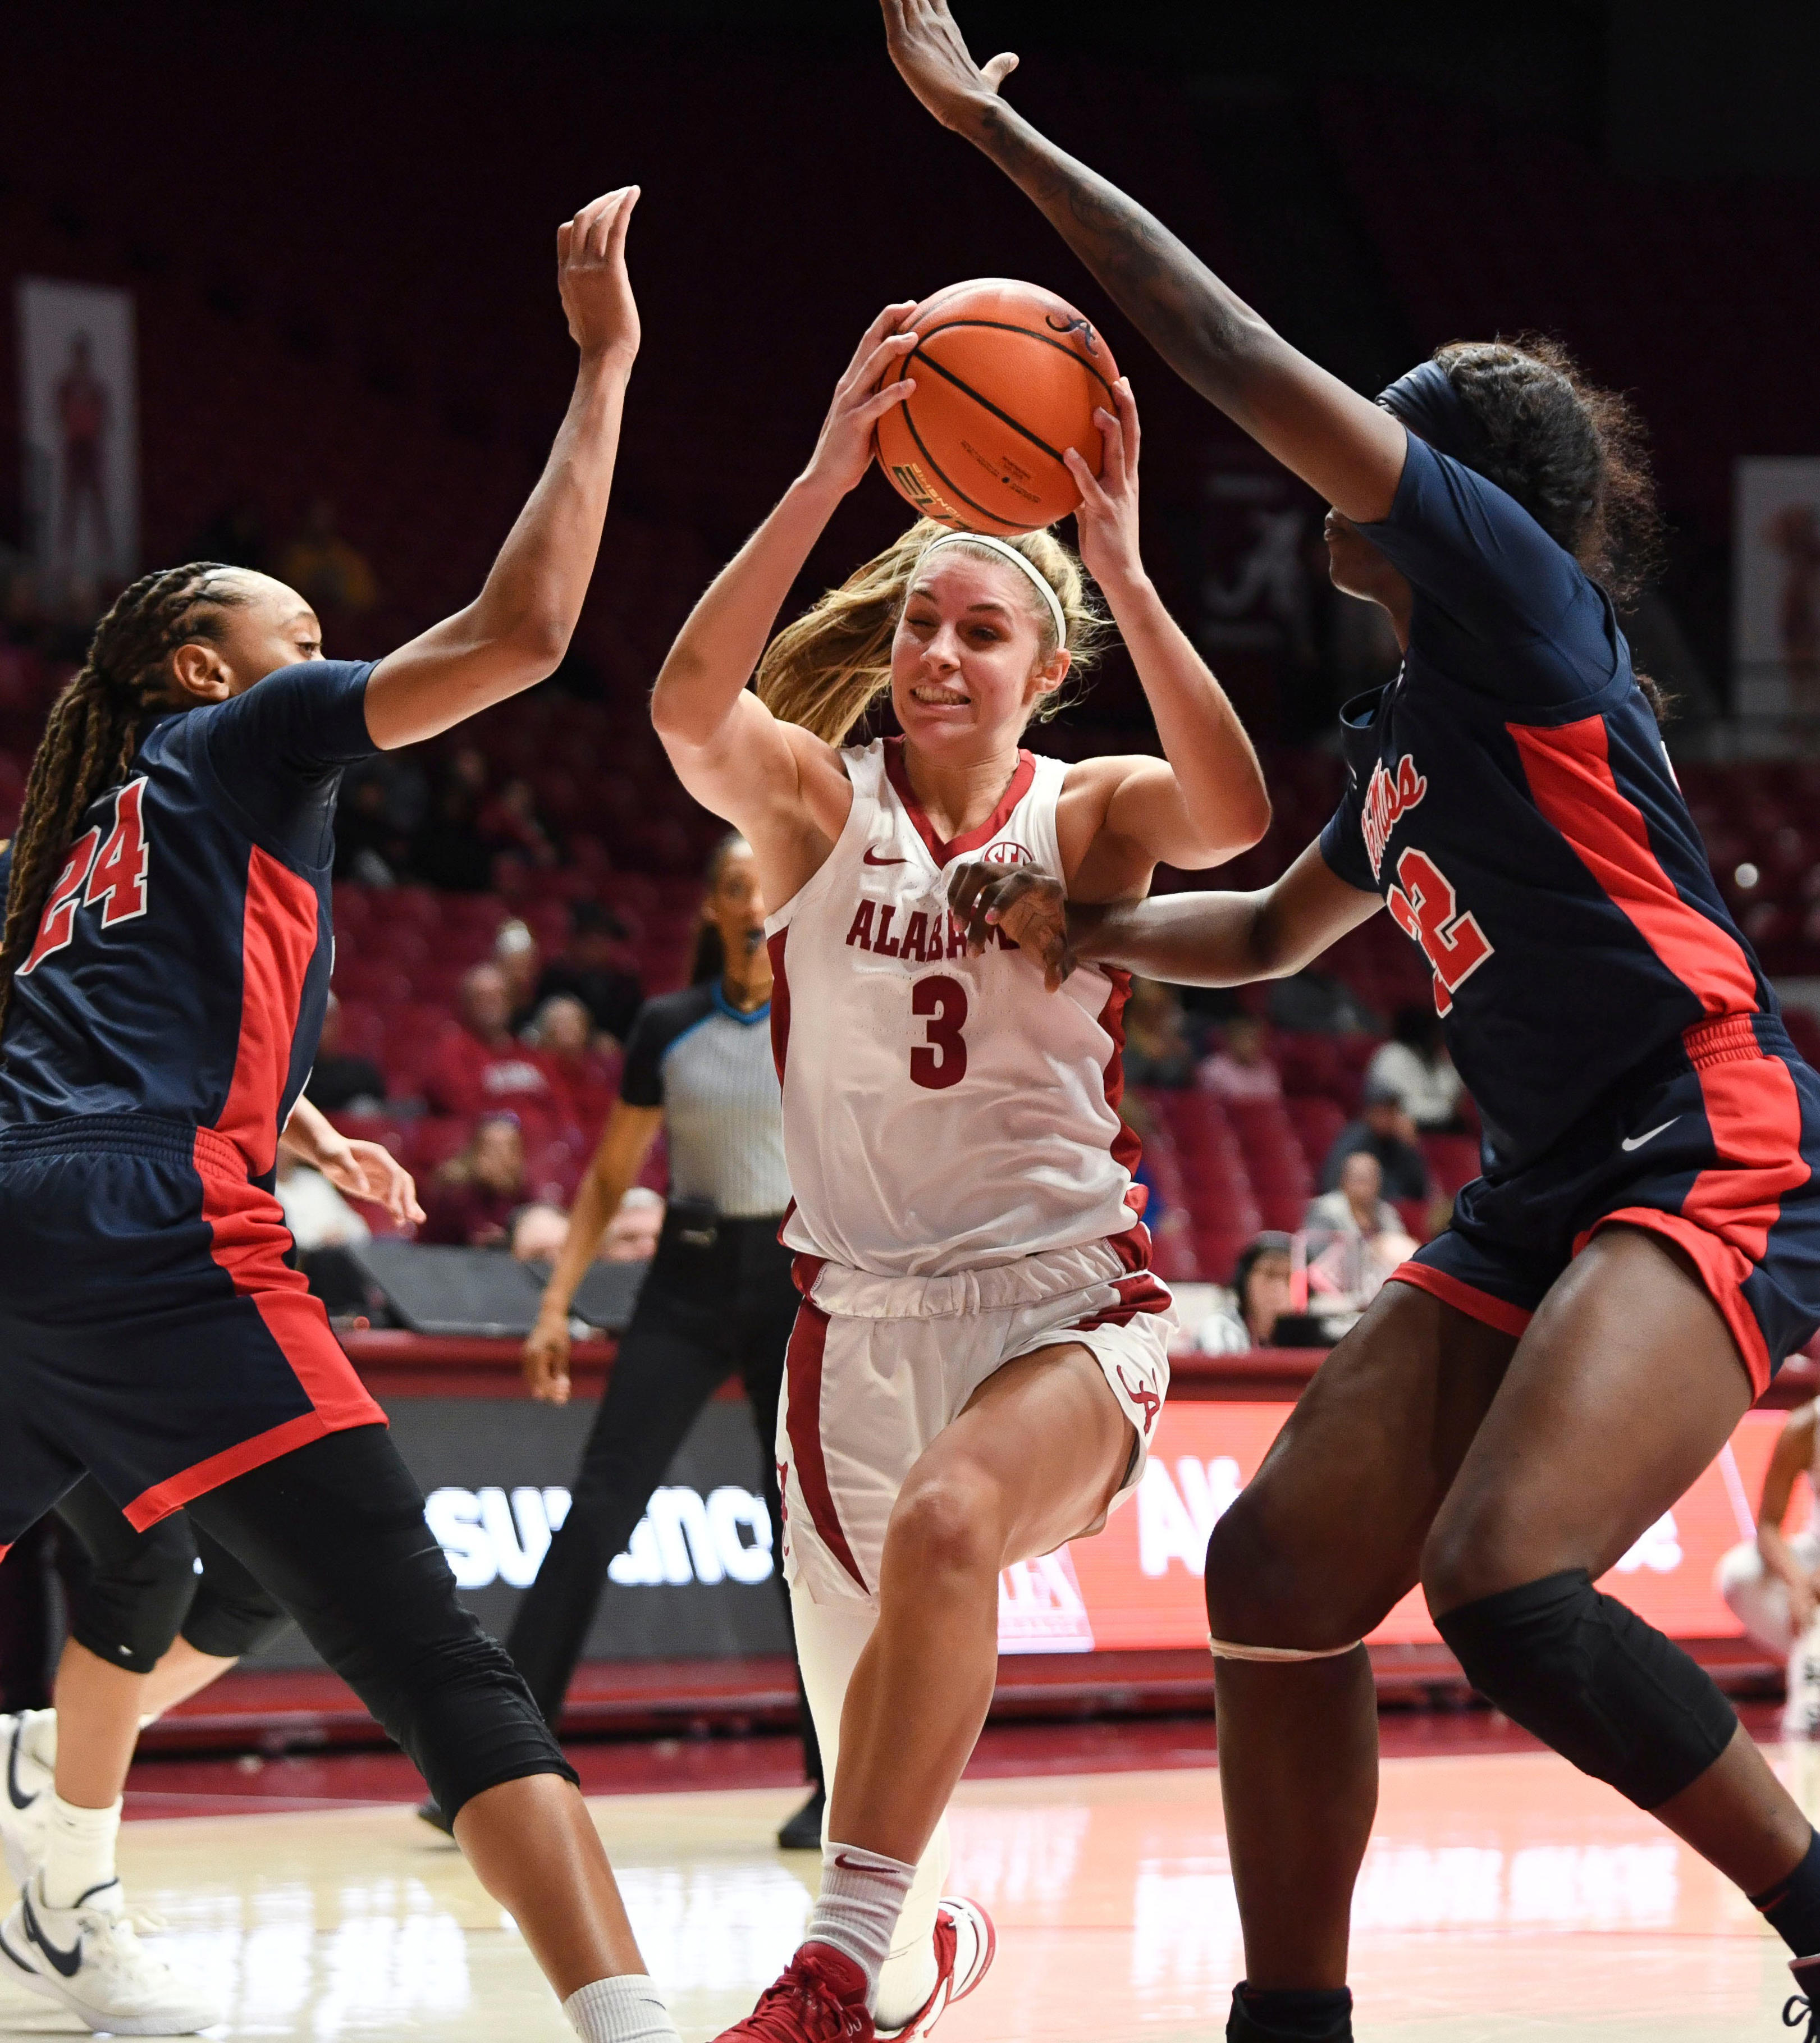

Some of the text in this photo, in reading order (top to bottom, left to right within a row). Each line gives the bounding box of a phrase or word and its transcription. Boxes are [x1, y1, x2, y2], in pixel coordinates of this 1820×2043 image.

[15, 776, 149, 976] 24
[845, 898, 1021, 962] ALABA
[910, 975, 968, 1090] 3
